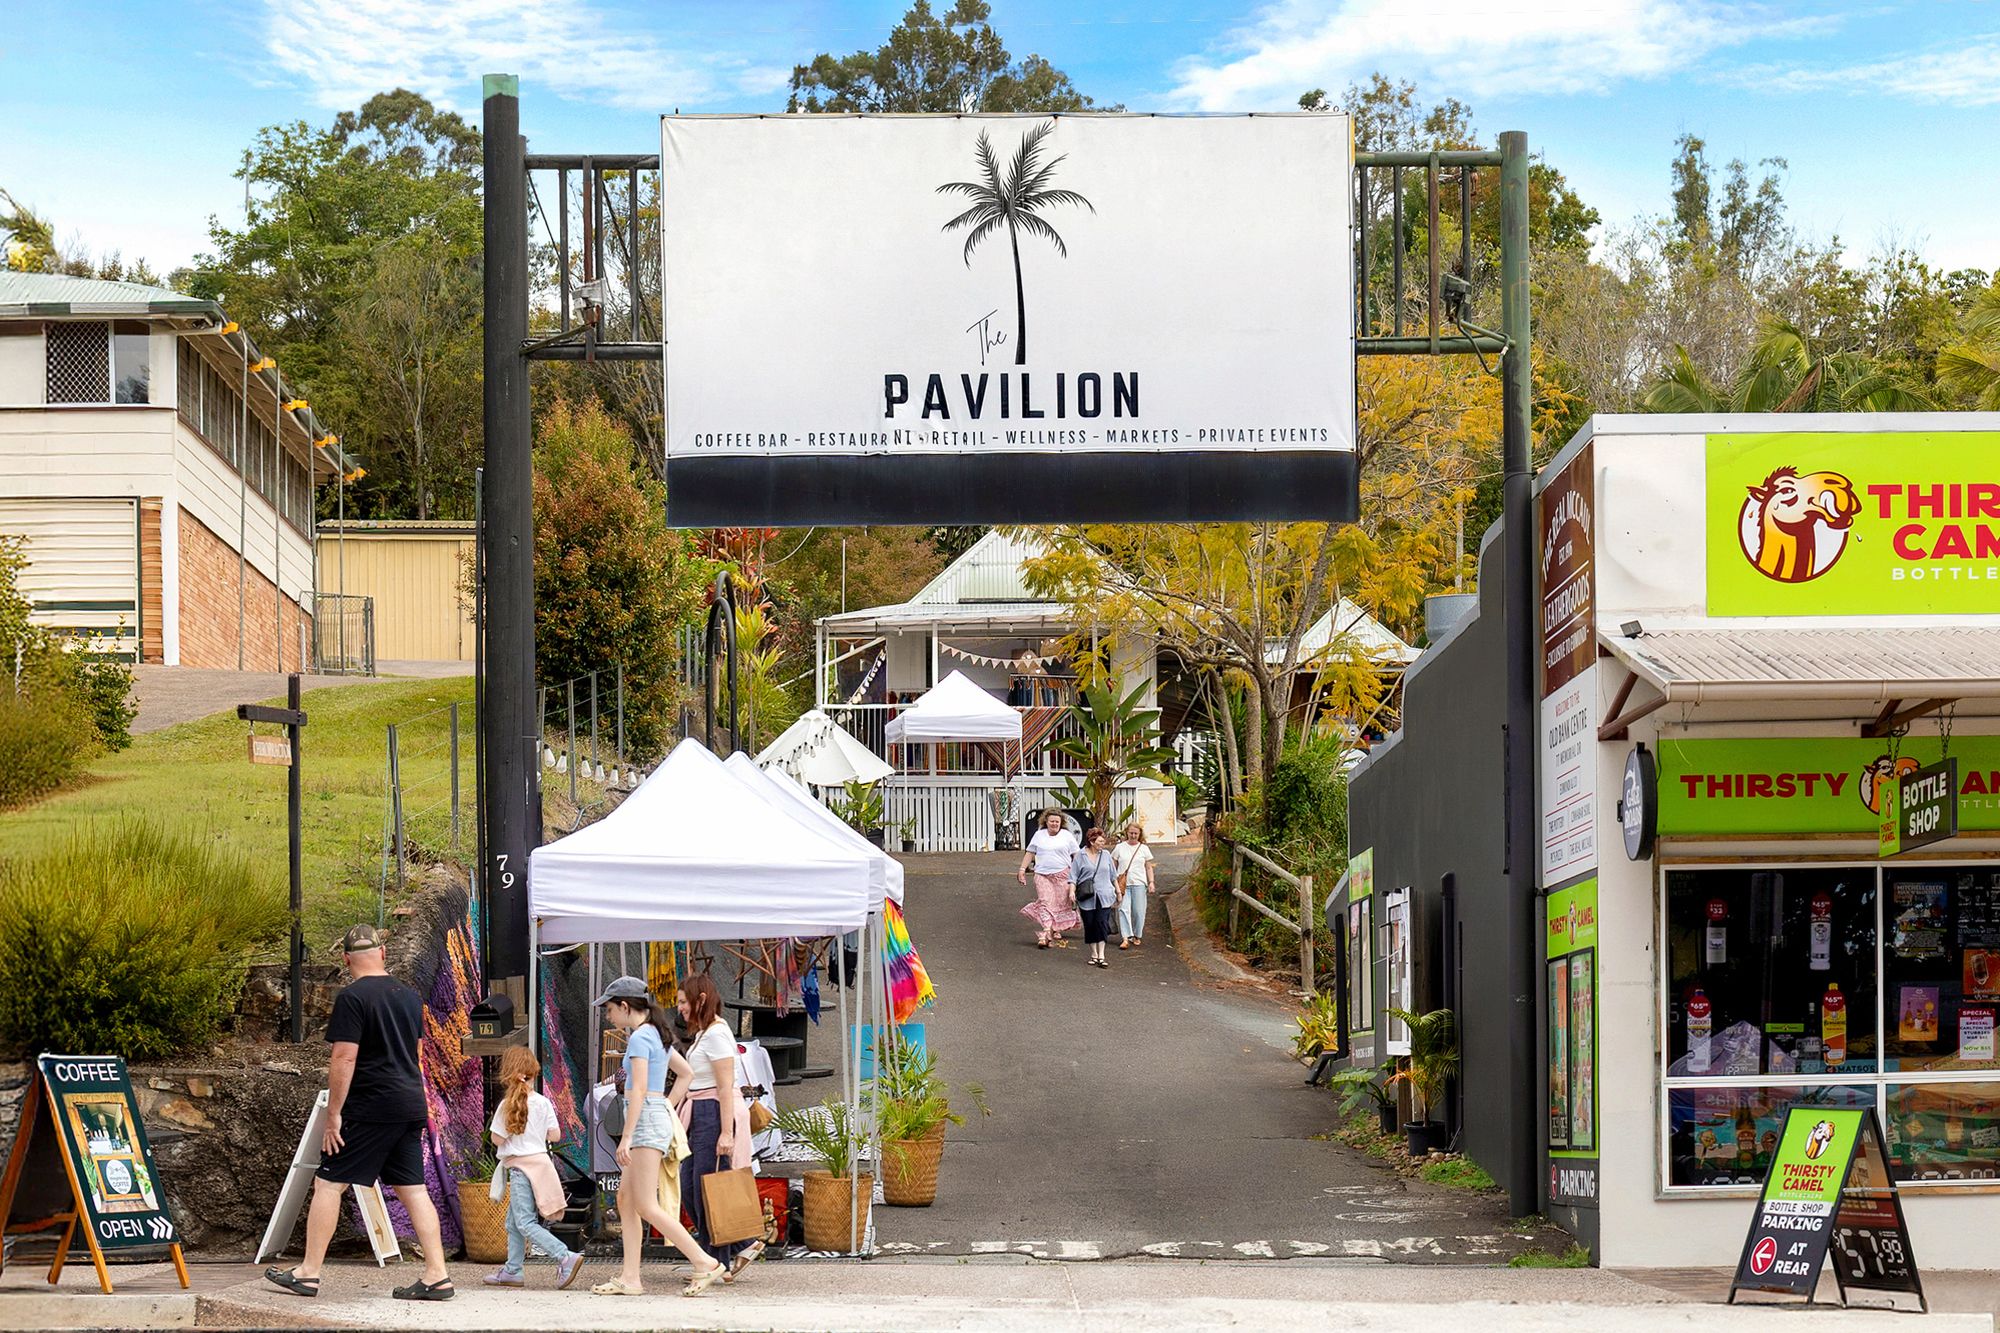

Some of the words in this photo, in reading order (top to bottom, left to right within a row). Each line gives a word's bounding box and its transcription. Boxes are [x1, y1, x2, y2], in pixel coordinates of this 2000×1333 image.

[966, 309, 1007, 366] The
[884, 371, 1140, 420] PAVILION
[695, 433, 752, 448] COFFEE
[758, 432, 788, 447] BAR
[932, 430, 986, 446] RETAIL
[1005, 429, 1087, 445] WELLNESS
[1106, 429, 1179, 444] MARKETS
[1198, 428, 1264, 443] PRIVATE
[1270, 427, 1329, 442] EVENTS
[1867, 483, 2000, 518] THIR
[1543, 528, 1553, 581] THE
[1552, 496, 1566, 545] REAL
[1891, 567, 1998, 580] BOTTLE
[1544, 571, 1590, 634] LEATHERGOODS
[1549, 727, 1558, 749] OLD
[1558, 718, 1570, 744] BANK
[1570, 707, 1587, 737] CENTRE
[1680, 773, 1849, 798] THIRSTY
[1903, 772, 1947, 809] BOTTLE
[1909, 805, 1940, 836] SHOP
[480, 1024, 492, 1034] 79
[55, 1063, 120, 1082] COFFEE
[1783, 1164, 1836, 1178] THIRSTY
[1560, 1169, 1595, 1198] PARKING
[1783, 1178, 1825, 1192] CAMEL
[1769, 1202, 1798, 1212] BOTTLE
[1801, 1203, 1824, 1214] SHOP
[99, 1219, 145, 1239] OPEN
[1761, 1215, 1823, 1232] PARKING
[1788, 1242, 1808, 1256] AT
[1774, 1260, 1810, 1276] REAR
